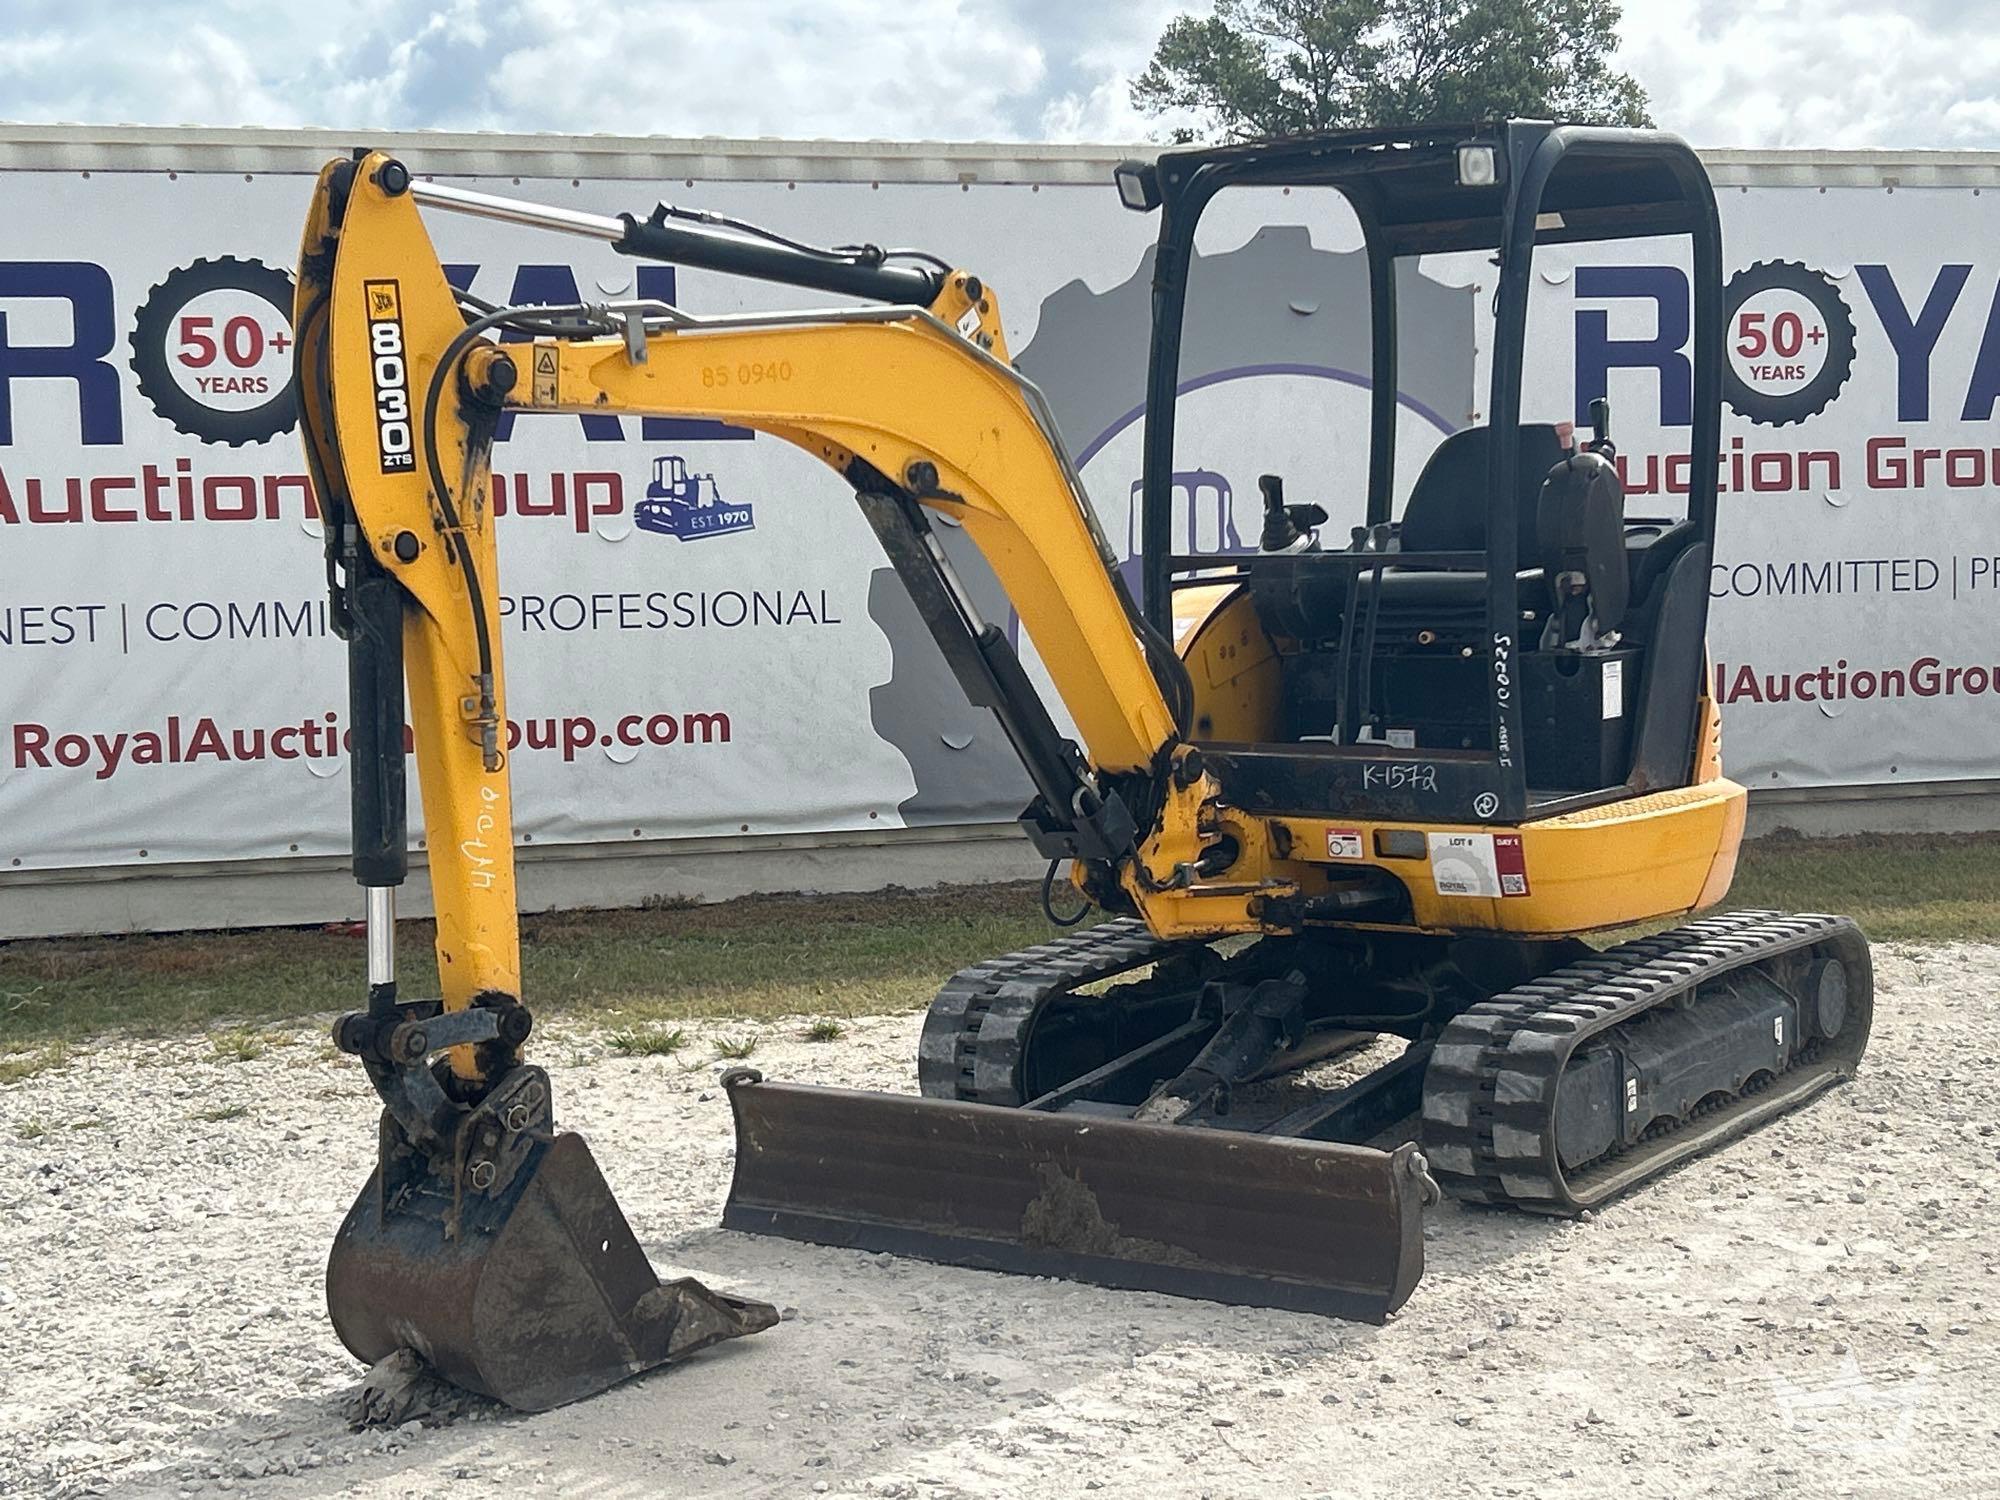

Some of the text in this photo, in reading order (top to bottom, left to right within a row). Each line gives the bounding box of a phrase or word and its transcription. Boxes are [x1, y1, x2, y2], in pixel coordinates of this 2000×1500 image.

[177, 315, 292, 369] 50+
[1736, 311, 1825, 359] 50+
[738, 360, 793, 386] 0940
[1749, 365, 1806, 380] YEARS
[195, 377, 268, 394] YEARS
[371, 322, 411, 455] 8030
[383, 453, 413, 467] ZTS
[717, 510, 749, 526] 1970
[1363, 764, 1438, 793] K-1572
[1449, 838, 1466, 847] LOT
